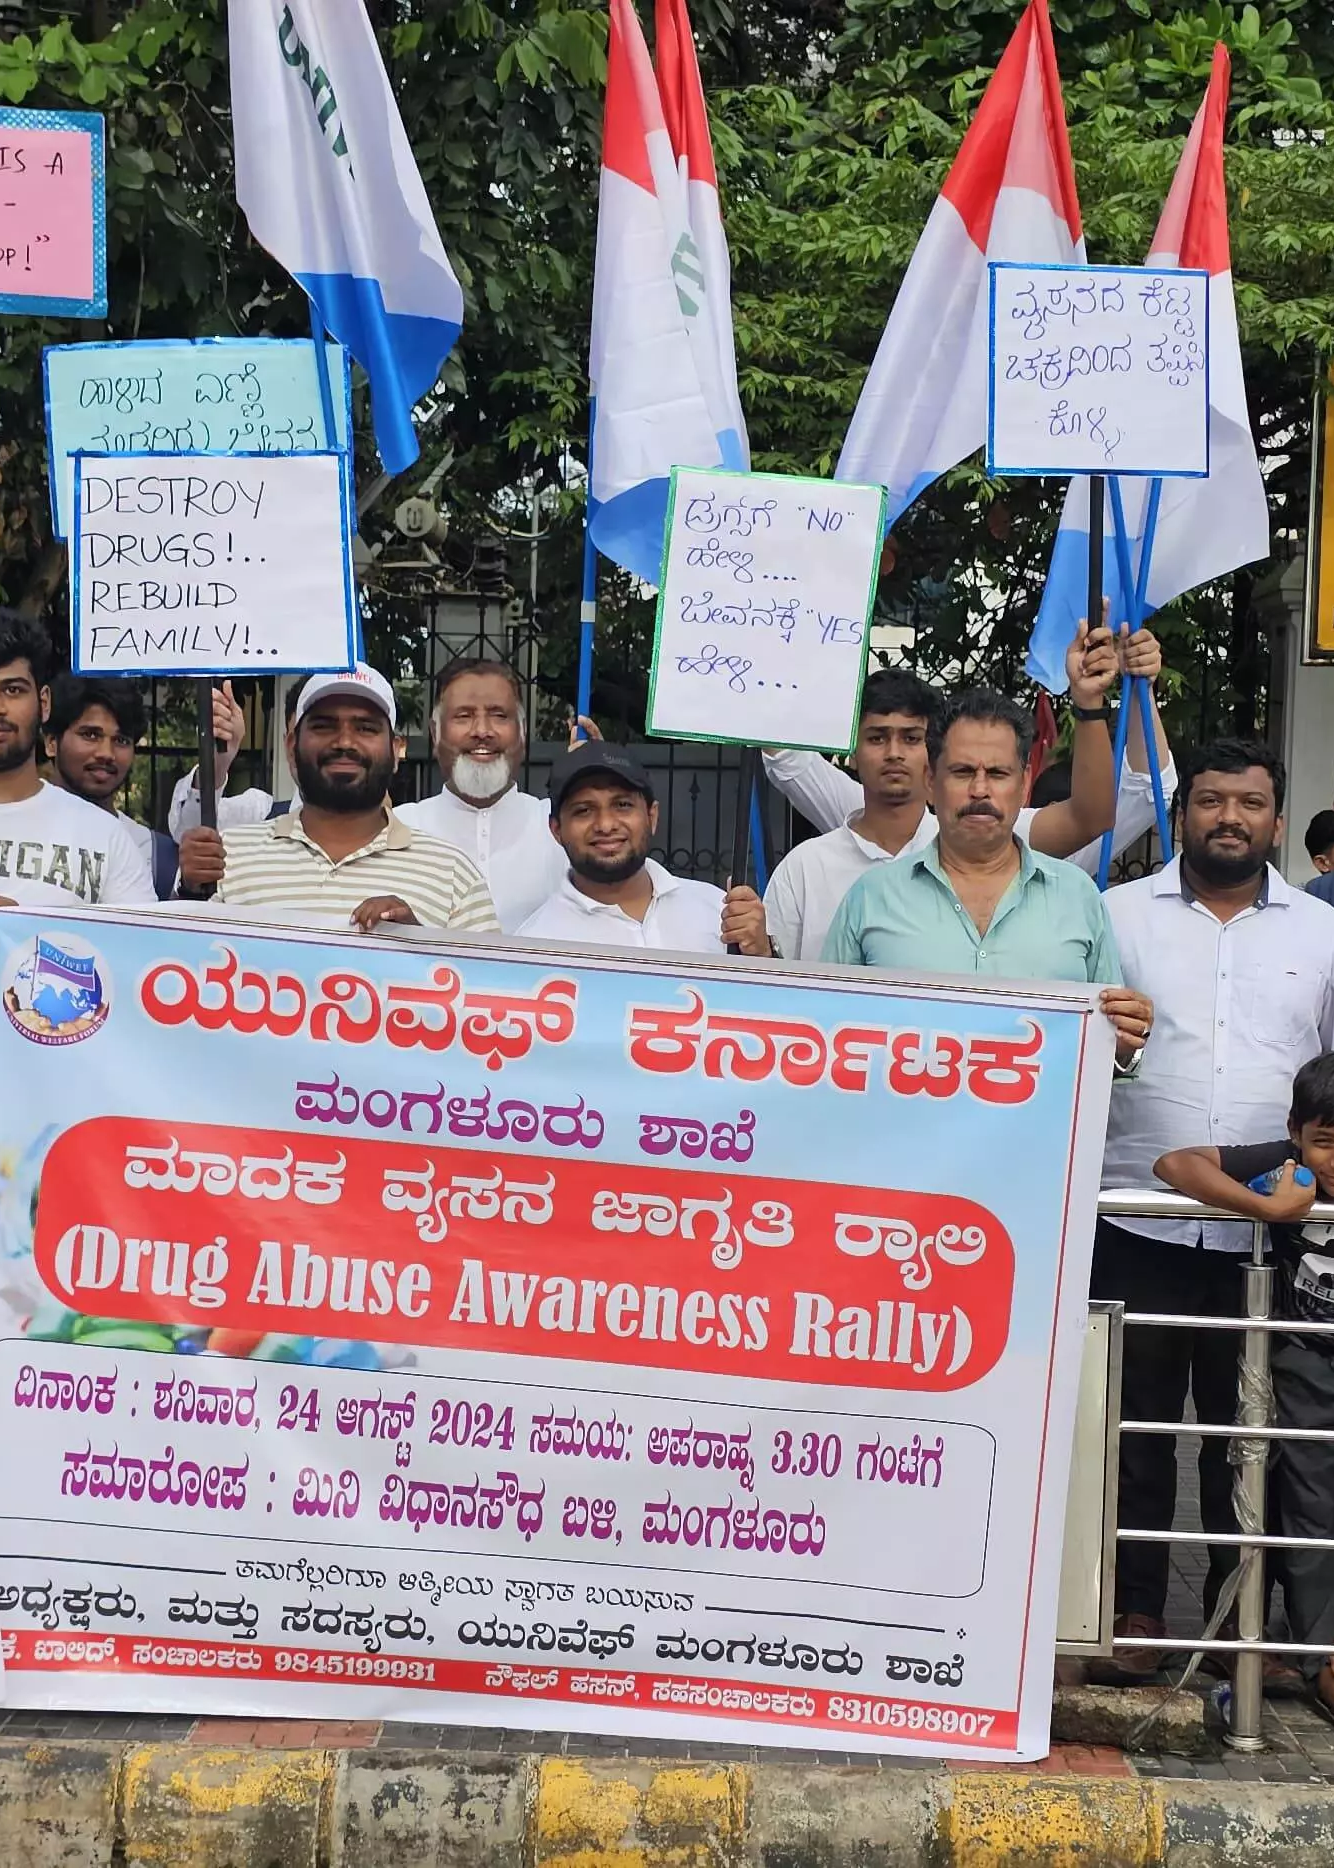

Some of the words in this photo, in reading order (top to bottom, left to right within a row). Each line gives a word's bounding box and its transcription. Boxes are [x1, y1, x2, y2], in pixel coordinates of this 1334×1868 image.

[43, 152, 64, 175] A
[1012, 280, 1124, 340] ವ್ಯಸನದ
[1138, 278, 1195, 337] ಕೆಟ್ಟ
[1006, 334, 1132, 390] ಚಕ್ರದಿಂದ
[81, 476, 265, 519] DESTROY
[798, 506, 855, 532] "NO"
[91, 580, 237, 614] REBUILD
[806, 609, 862, 644] "YES
[140, 945, 576, 1071] ಯುನಿವೆಫ್
[628, 988, 1044, 1105] ಕರ್ನಾಟಕ
[295, 1071, 605, 1149] ಮಂಗಳೂರು
[639, 1109, 756, 1162] ಶಾಖೆ
[123, 1135, 347, 1204] ಮಾದಕ
[382, 1158, 555, 1243] ವ್ಯಸನ
[591, 1187, 794, 1270] ಜಾಗೃತಿ
[55, 1223, 230, 1308] (Drug
[247, 1240, 431, 1319] Abuse
[449, 1259, 769, 1351] Awareness
[789, 1291, 973, 1376] Rally)
[14, 1363, 118, 1415] ದಿನಾಂಕ
[153, 1369, 261, 1434] ಶನಿವಾರ,
[277, 1384, 321, 1433] 24
[336, 1388, 416, 1468] ಆಗಸ್ಟ್
[429, 1398, 516, 1452] 2024
[529, 1402, 633, 1462] ಸಮಯ:
[771, 1430, 842, 1478] 3.30
[856, 1431, 944, 1488] ಗಂಟೆಗೆ
[61, 1438, 249, 1511] ಸಮಾರೋಪ
[293, 1467, 360, 1519] ಮಿನಿ
[379, 1471, 546, 1542] ವಿಧಾನಸೌಧ
[562, 1496, 622, 1546] ಬಳಿ,
[642, 1489, 826, 1557] ಮಂಗಳೂರು
[236, 1557, 387, 1593] ತಮಗೆಲ್ಲರಿಗೂ
[397, 1571, 493, 1607] ಆತ್ಮೀಯ
[505, 1578, 575, 1612] ಸ್ವಾಗತ
[585, 1586, 694, 1613] ಬಯಸುವ
[167, 1594, 260, 1640] ಮತ್ತು
[281, 1599, 434, 1654] ಸದಸ್ಯರು,
[457, 1613, 635, 1661] ಯುನಿವೆಫ್
[655, 1629, 863, 1676] ಮಂಗಳೂರು
[885, 1653, 965, 1688] ಶಾಖೆ
[132, 1640, 263, 1671] ಸಂಚಾಲಕರು
[274, 1652, 436, 1682] 9845199931
[485, 1662, 560, 1695] ನೌಫಲ್
[569, 1672, 641, 1702] ಹಸನ್,
[651, 1678, 815, 1718] ಸಹಸಂಚಾಲಕರು
[826, 1696, 996, 1738] 8310598907
